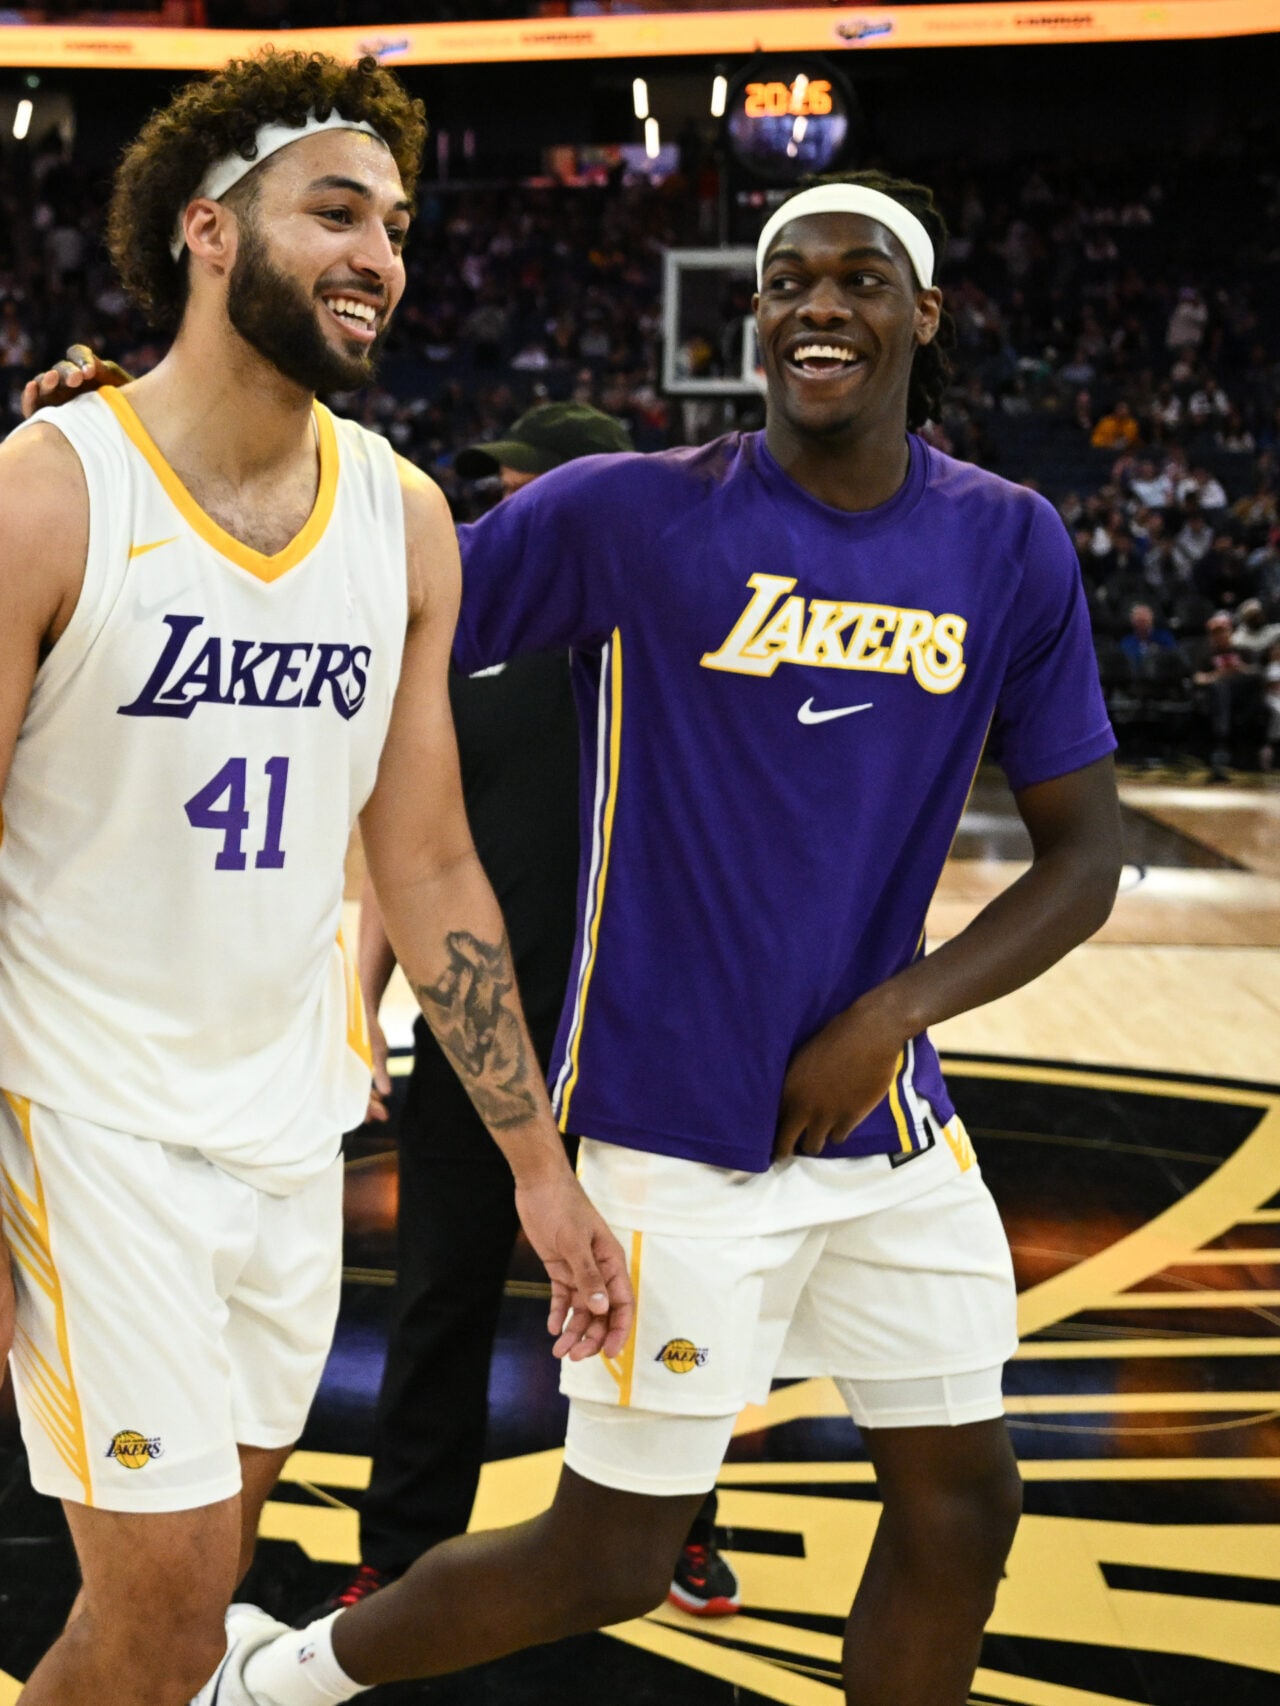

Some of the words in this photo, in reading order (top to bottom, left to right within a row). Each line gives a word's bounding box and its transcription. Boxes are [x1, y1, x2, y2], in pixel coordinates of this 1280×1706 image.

[116, 614, 372, 721] LAKERS
[699, 572, 968, 694] LAKERS
[184, 756, 289, 871] 41
[104, 1439, 165, 1459] LAKERS
